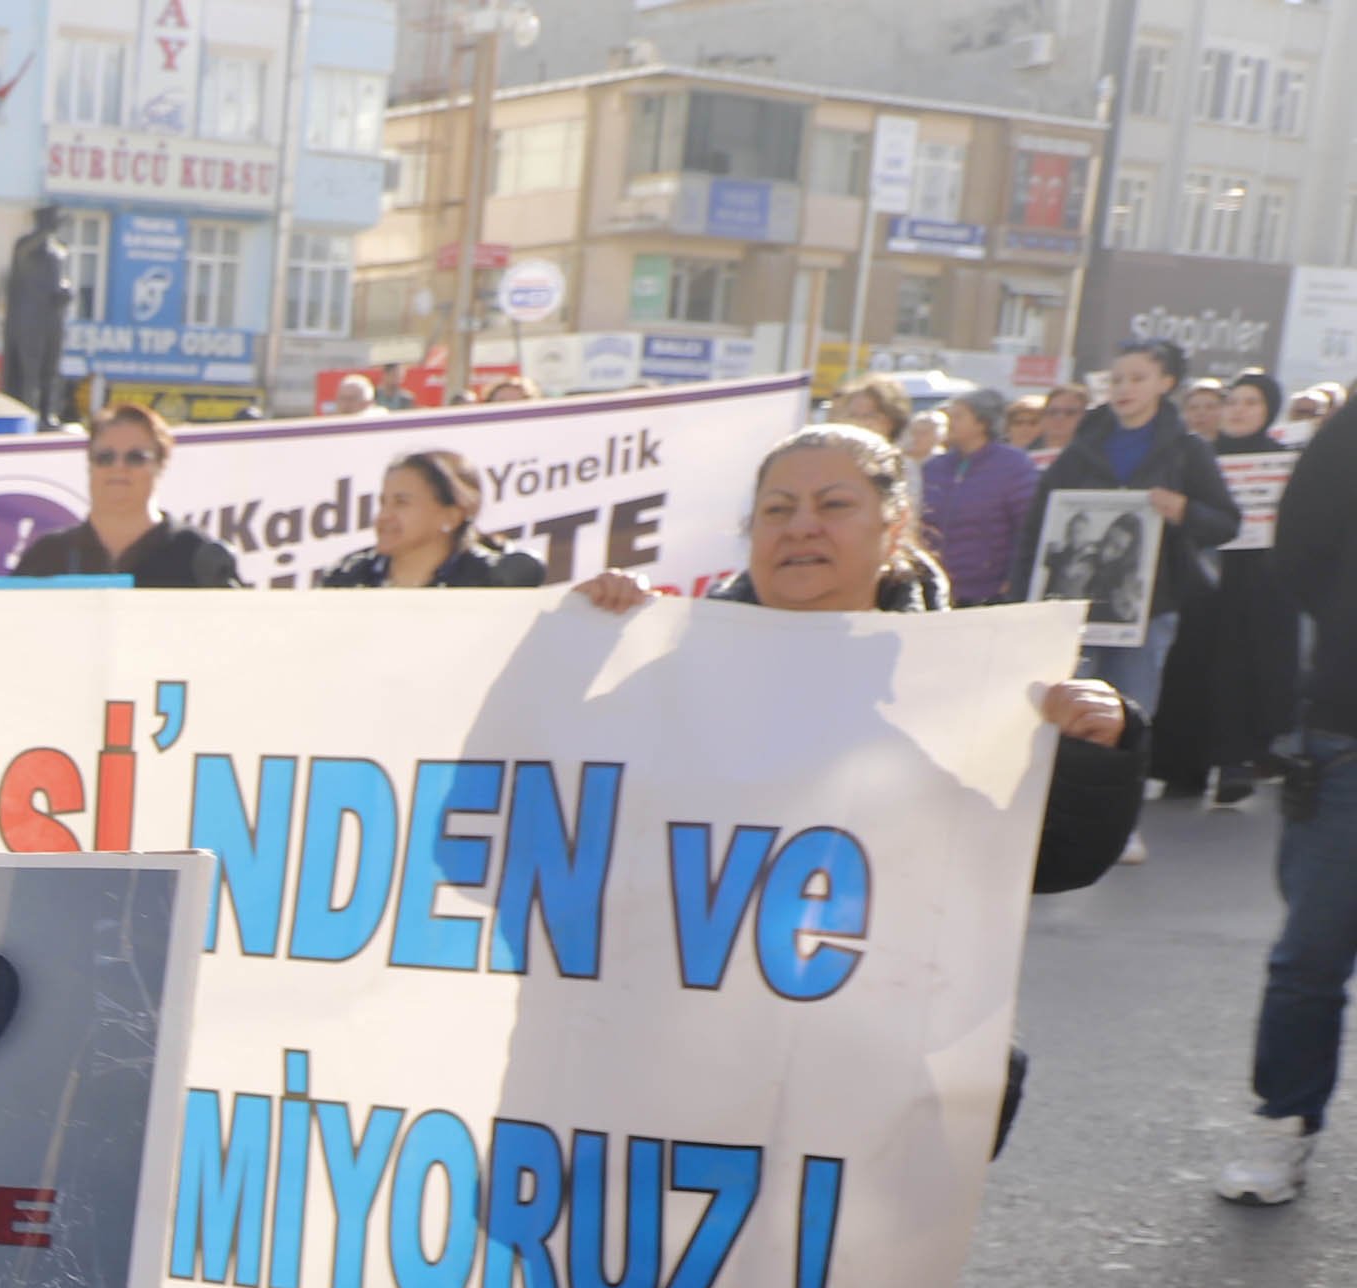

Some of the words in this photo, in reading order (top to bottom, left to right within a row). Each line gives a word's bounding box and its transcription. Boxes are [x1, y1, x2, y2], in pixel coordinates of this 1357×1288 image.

[46, 133, 171, 187] SÜRÜCÜ
[178, 153, 278, 196] KURSU
[484, 428, 662, 502] Yönelik
[666, 820, 874, 1002] ve
